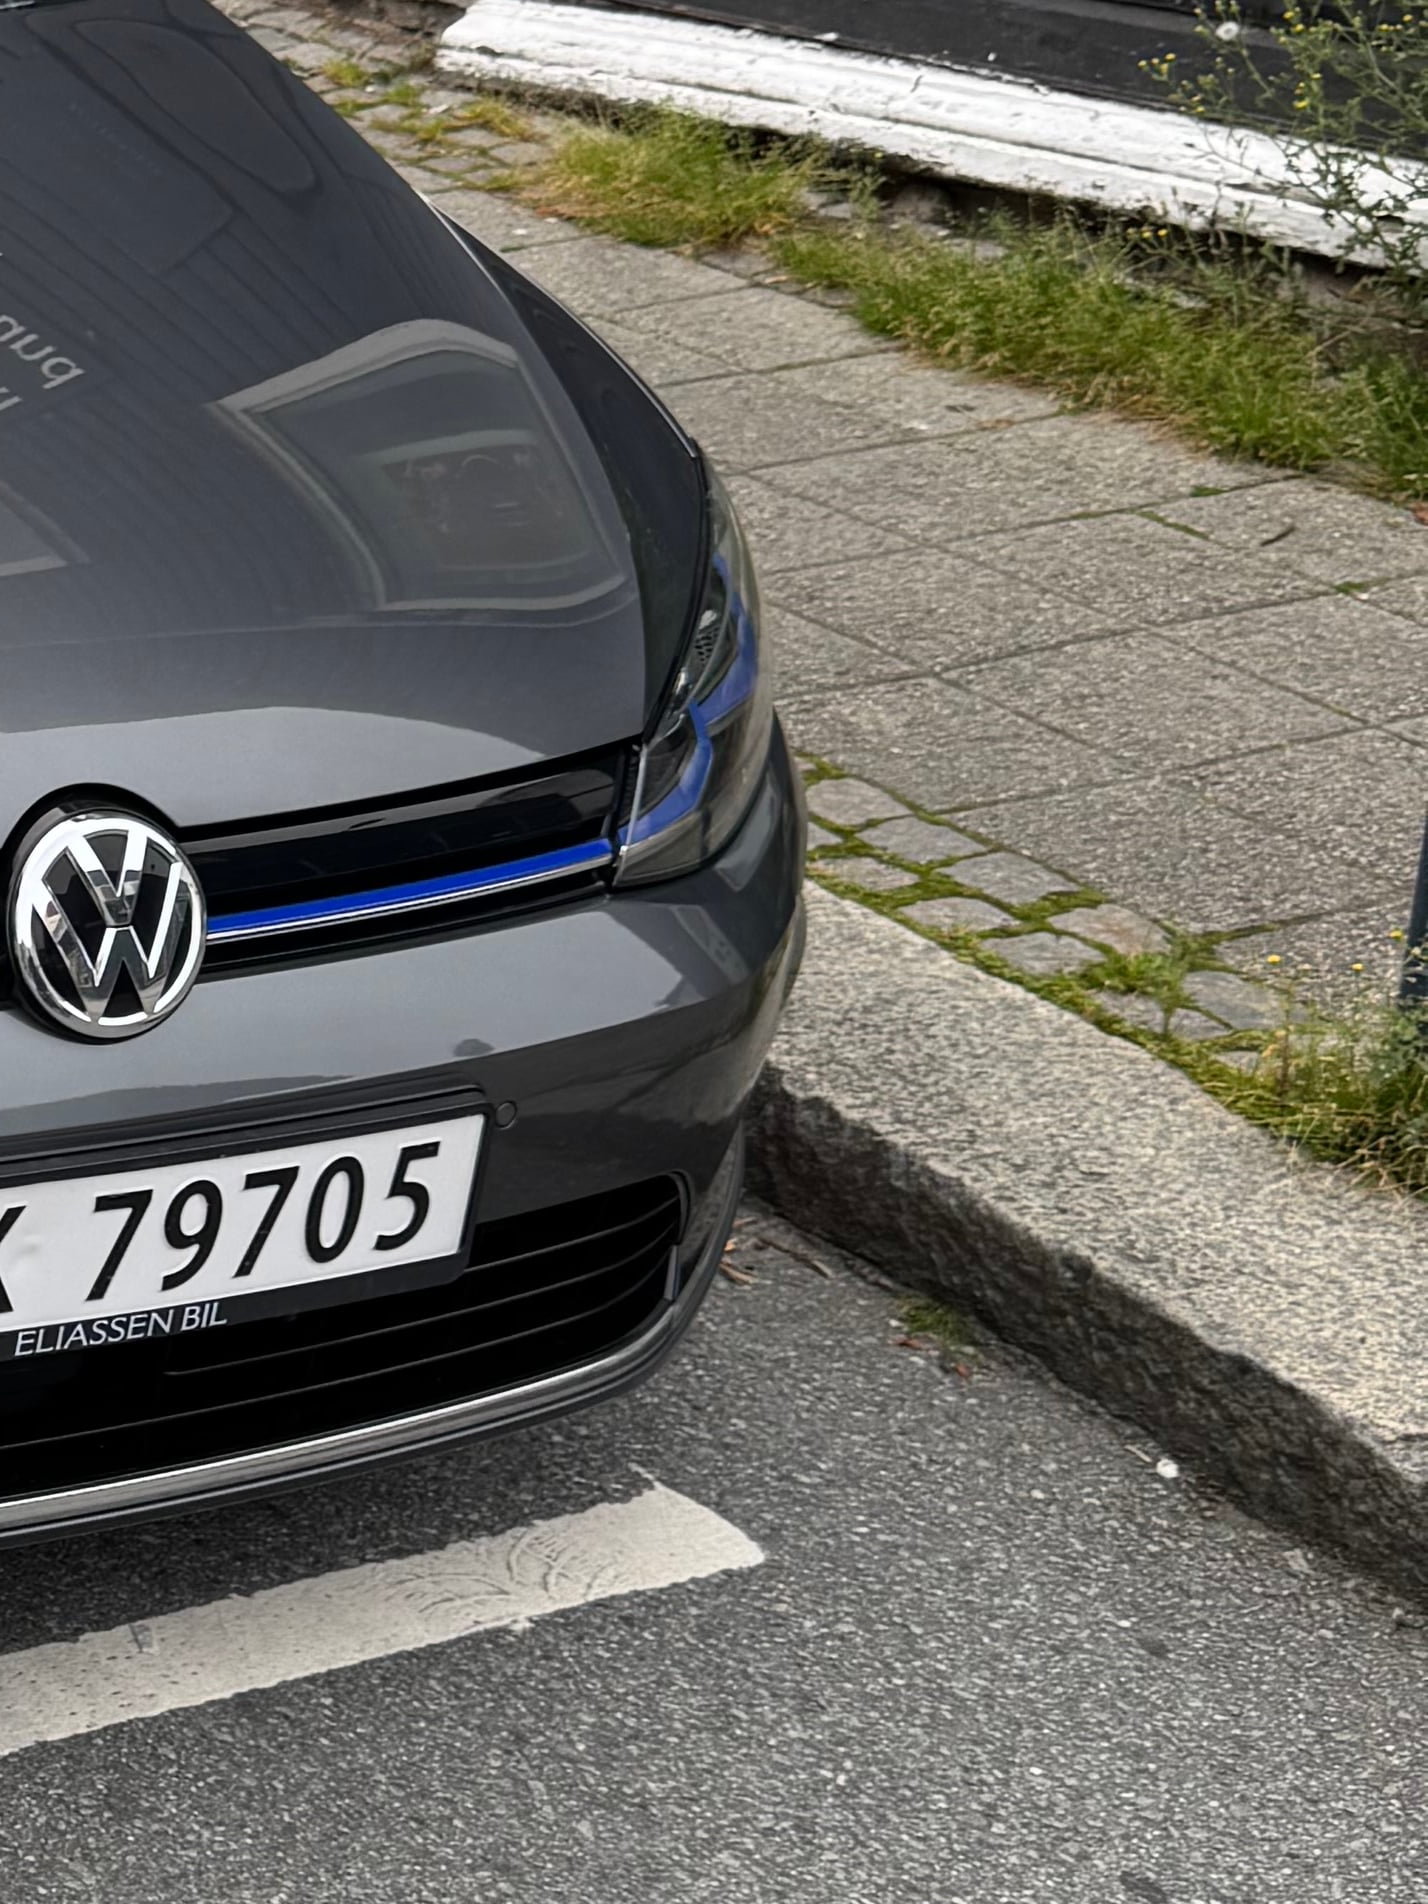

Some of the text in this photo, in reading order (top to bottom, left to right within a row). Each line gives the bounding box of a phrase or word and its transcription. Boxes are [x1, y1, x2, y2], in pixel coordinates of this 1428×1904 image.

[24, 821, 184, 1021] VW
[85, 1140, 442, 1302] 79705
[14, 1301, 228, 1357] ELIASSEN BIL
